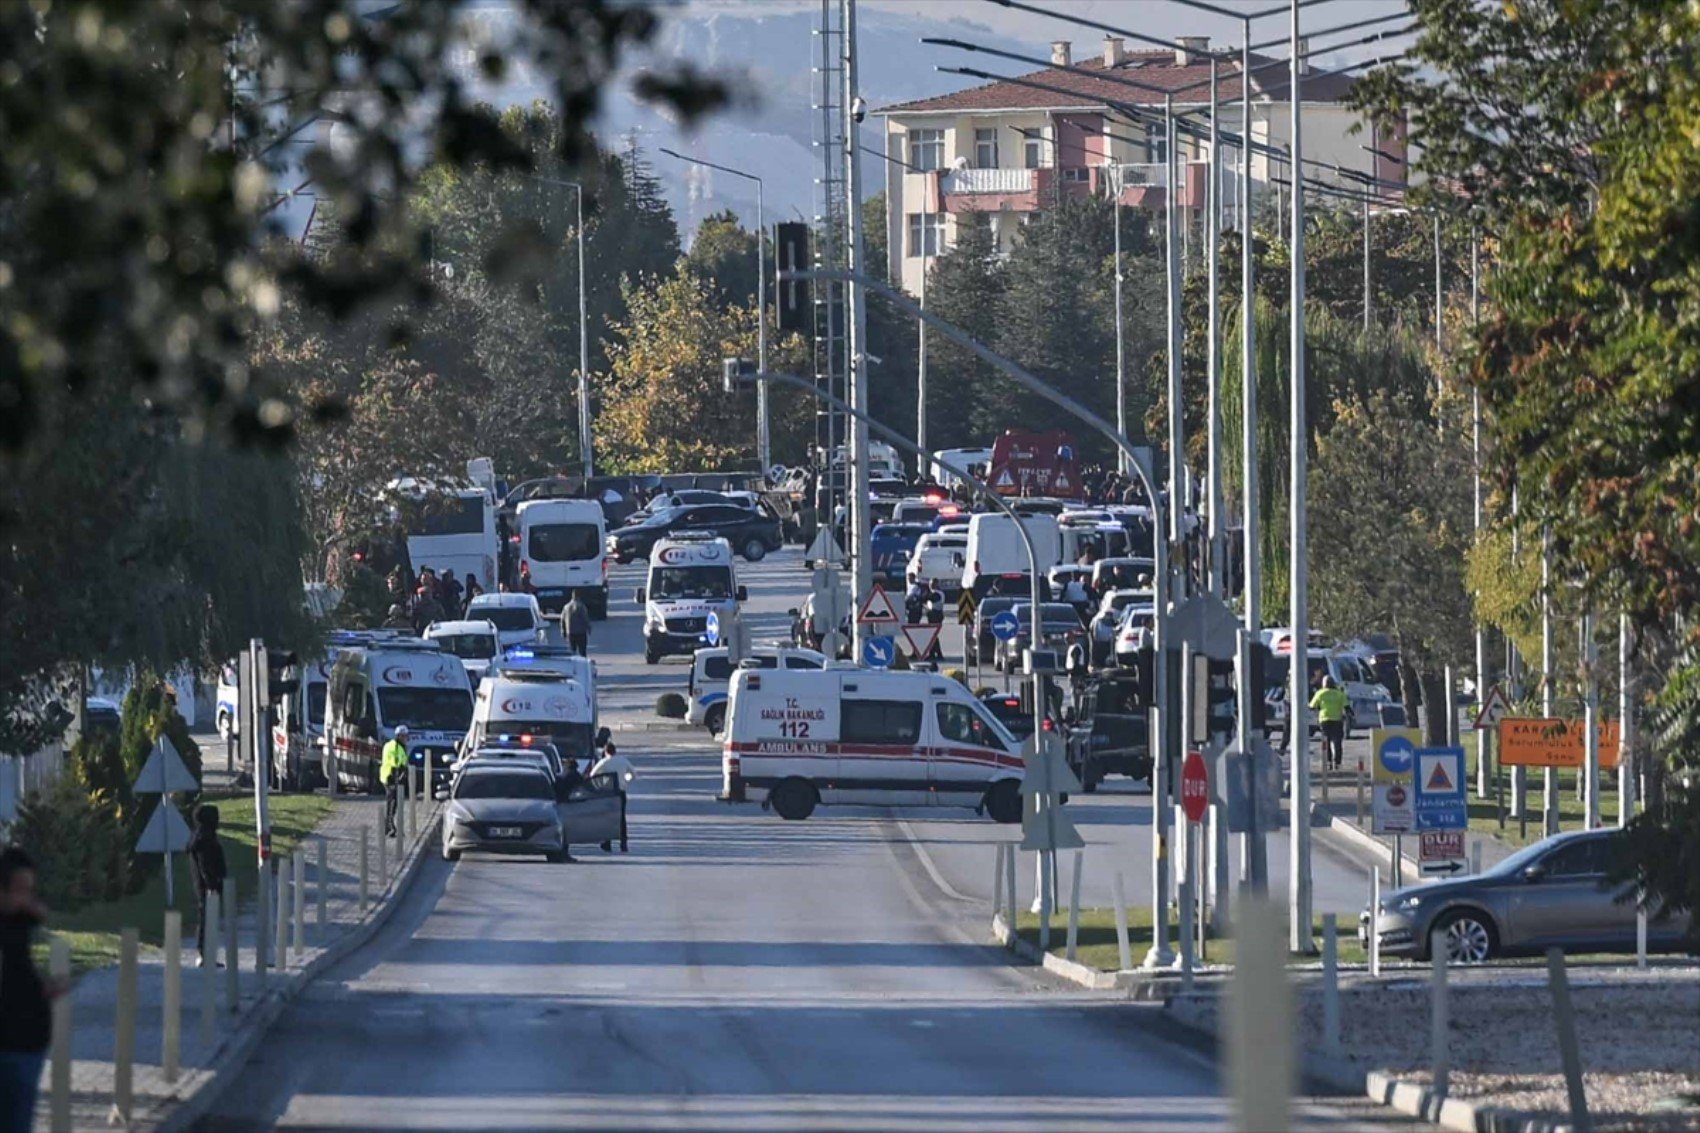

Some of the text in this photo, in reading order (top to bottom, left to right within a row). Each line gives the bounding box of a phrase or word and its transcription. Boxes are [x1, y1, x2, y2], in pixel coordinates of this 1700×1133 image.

[667, 551, 687, 559] 112
[511, 701, 532, 711] 112
[761, 707, 825, 720] SAĞLIK BAKANLIĞI
[779, 721, 809, 738] 112
[758, 741, 827, 754] AMBULANS
[1184, 778, 1207, 797] DUR
[1423, 833, 1460, 846] DUR
